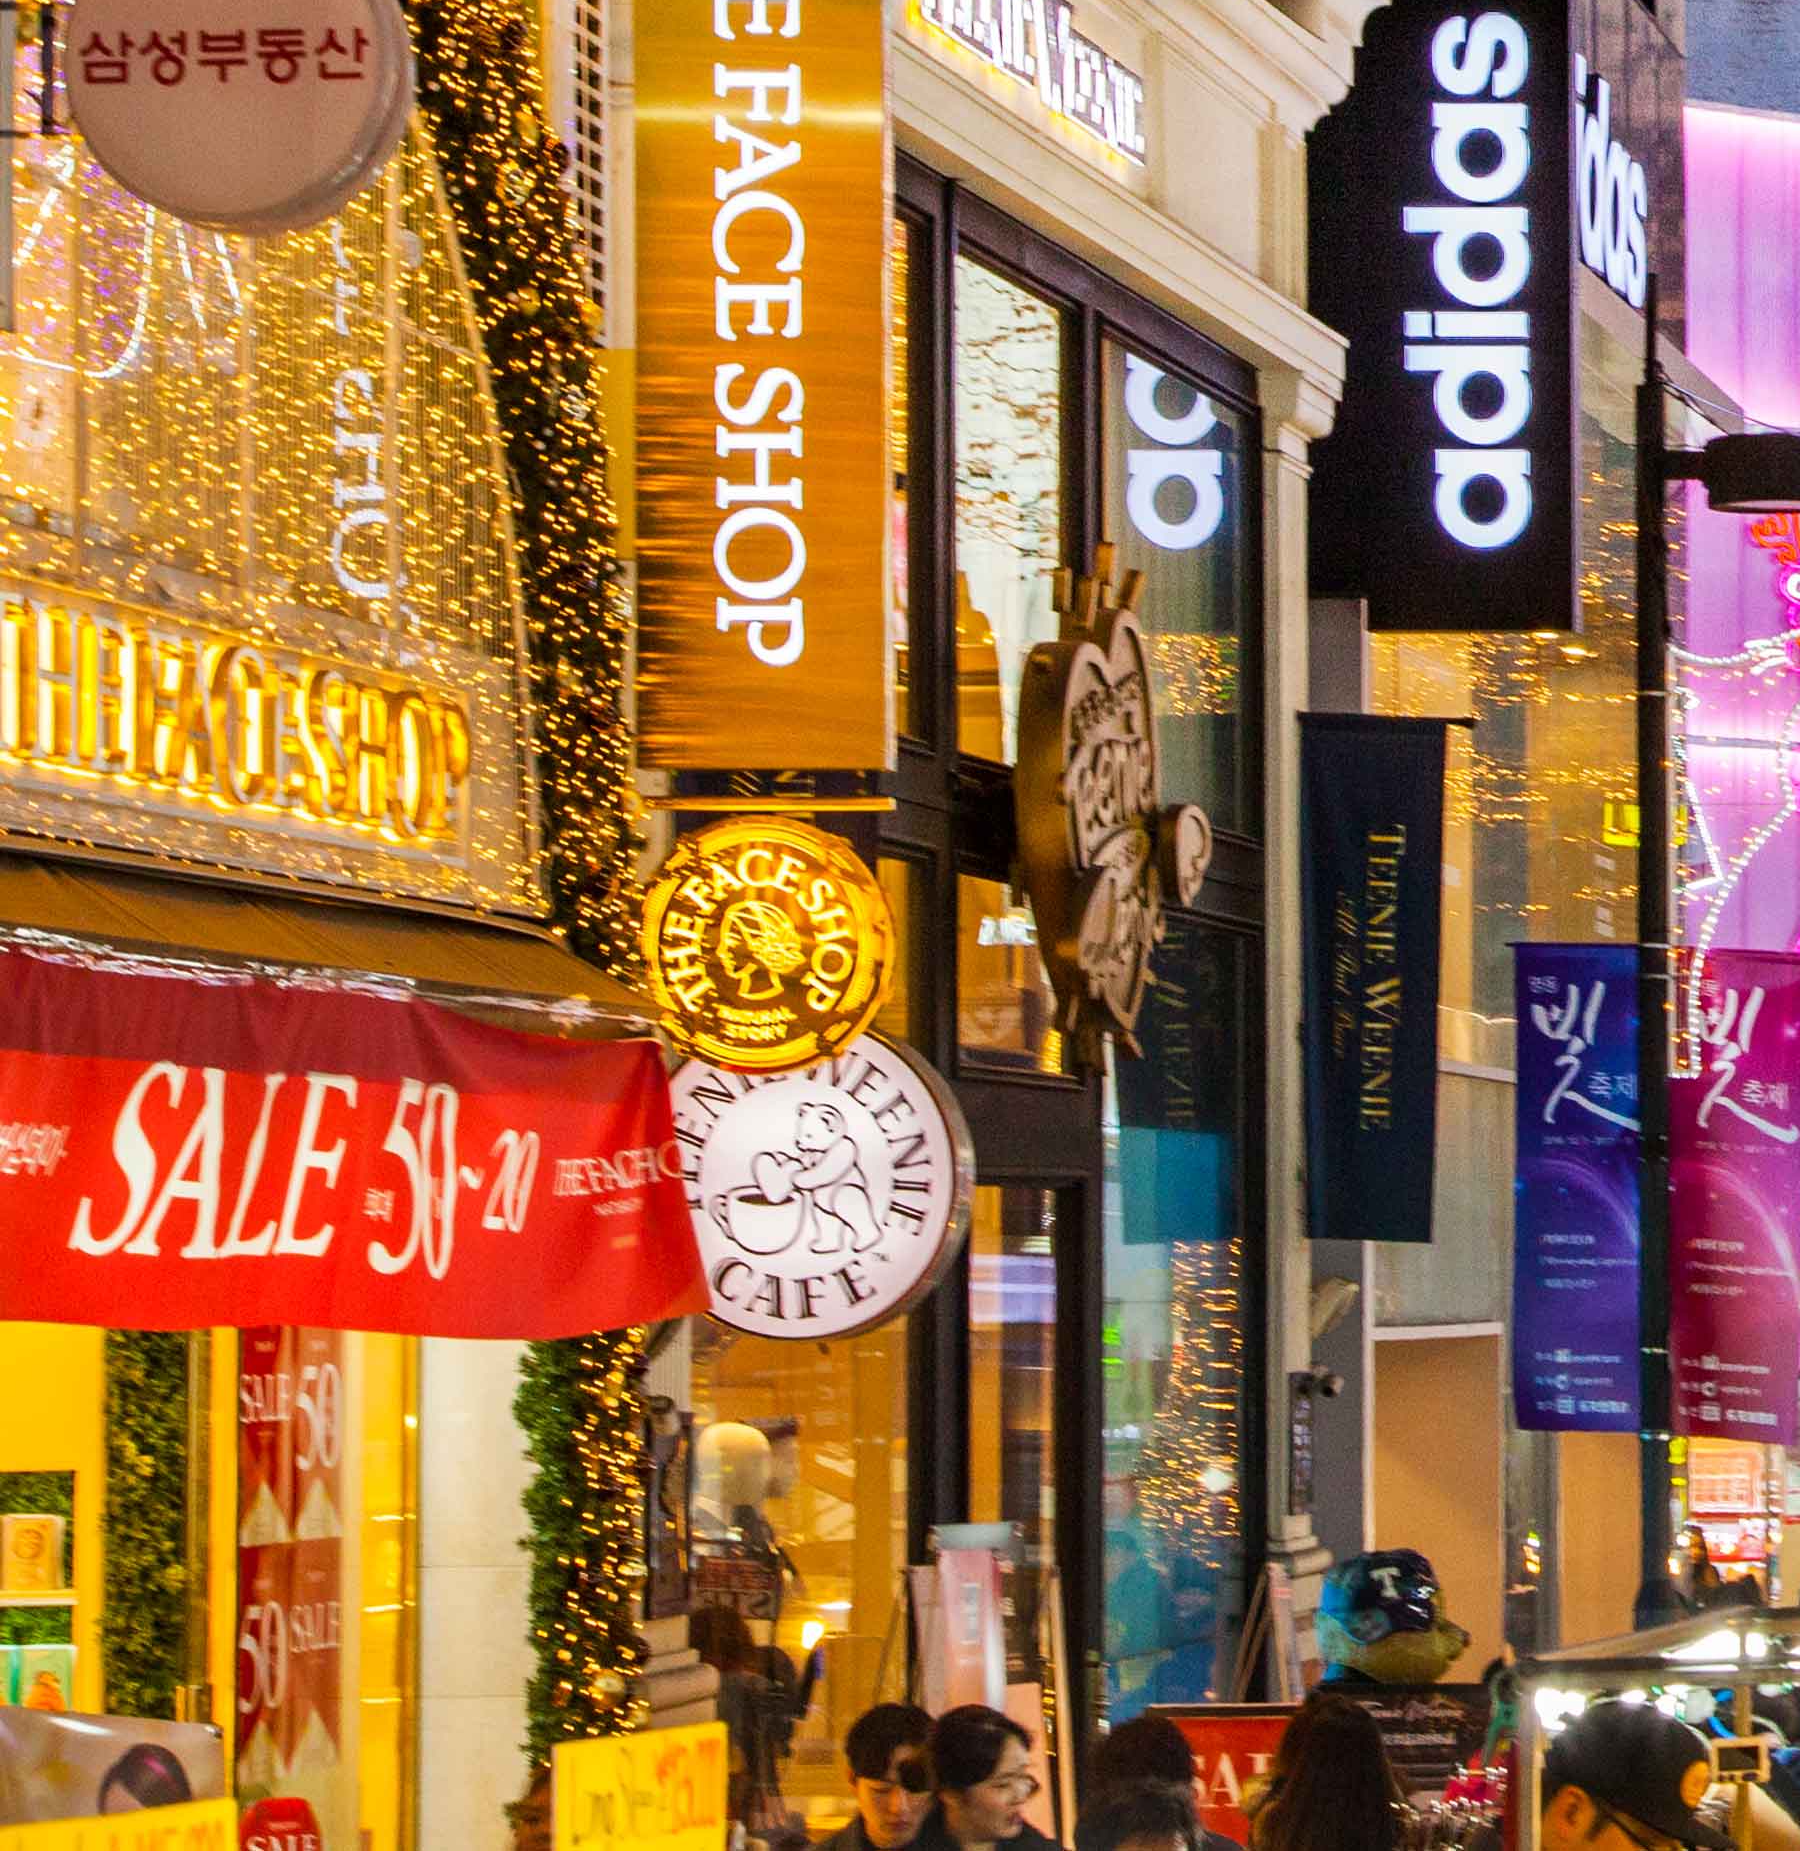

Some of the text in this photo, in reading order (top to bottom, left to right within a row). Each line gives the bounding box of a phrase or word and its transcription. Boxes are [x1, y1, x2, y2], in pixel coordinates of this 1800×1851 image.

[79, 28, 370, 87] 삼성부동산
[712, 64, 805, 341] FACE
[1405, 11, 1532, 549] adidas
[712, 364, 806, 667] SHOP
[662, 849, 854, 1013] THE FACE SHOP
[67, 1062, 357, 1259] SALE
[711, 1257, 879, 1319] CAFE
